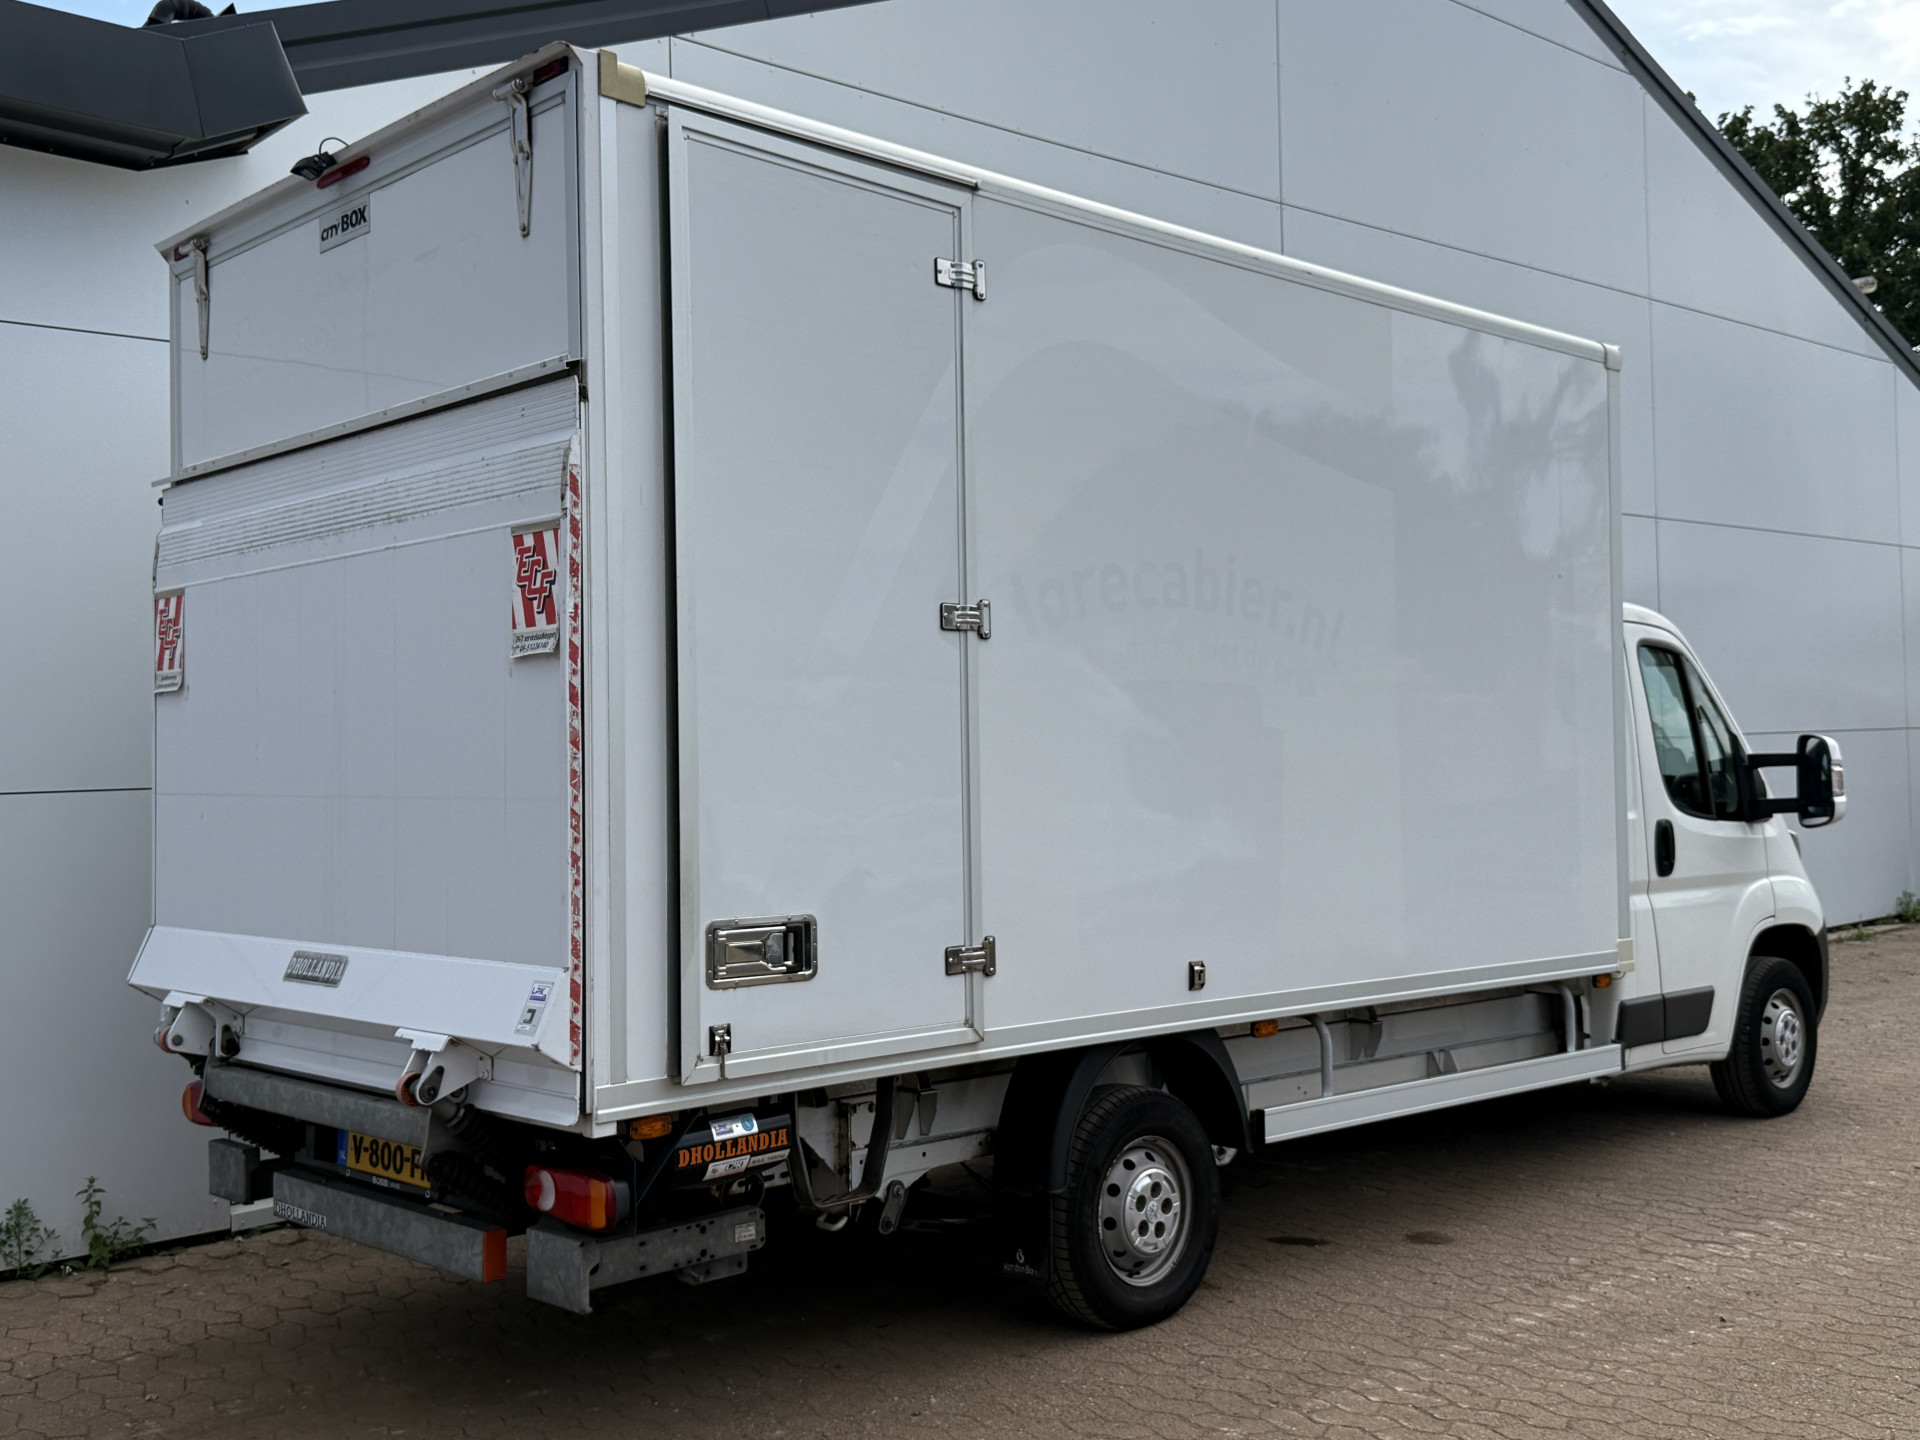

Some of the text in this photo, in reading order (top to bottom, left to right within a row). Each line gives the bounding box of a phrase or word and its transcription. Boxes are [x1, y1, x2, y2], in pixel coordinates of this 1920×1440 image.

[321, 204, 367, 241] CITY BOX
[516, 545, 556, 614] ECF
[158, 607, 181, 660] ECF
[287, 957, 345, 980] DHOLLANDIA
[678, 1128, 788, 1168] DHOLLANDIA
[274, 1202, 327, 1229] DHOLLANDIA
